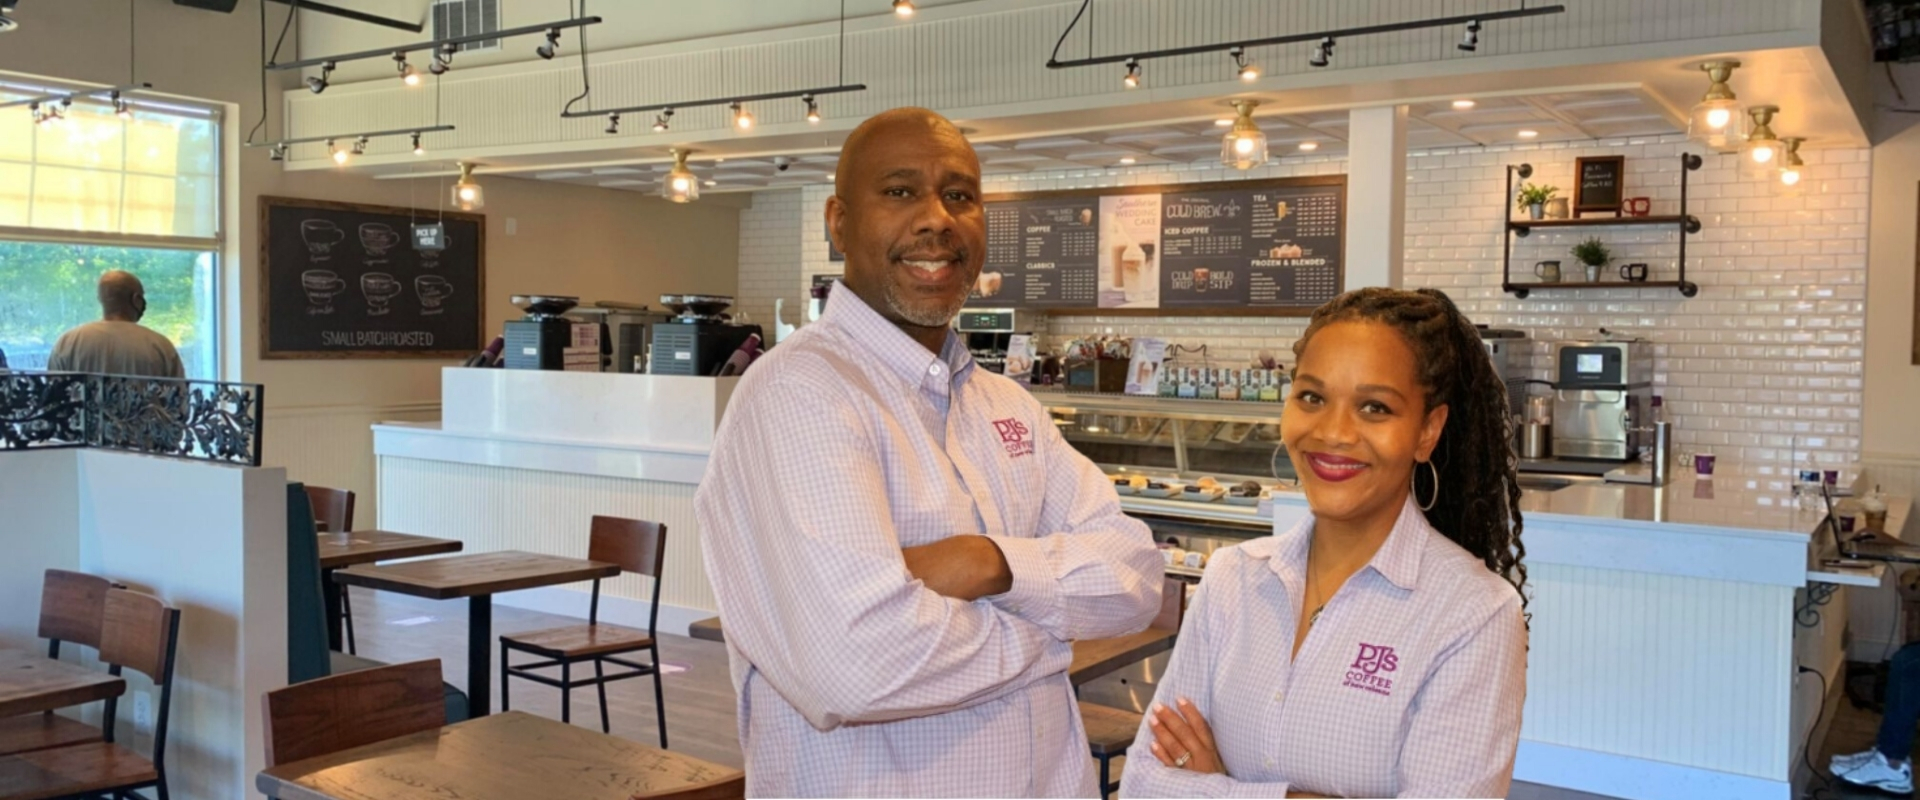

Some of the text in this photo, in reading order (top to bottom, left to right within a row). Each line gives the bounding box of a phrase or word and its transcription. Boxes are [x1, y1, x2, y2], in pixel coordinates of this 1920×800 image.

[1253, 194, 1267, 202] TEA
[1115, 208, 1157, 218] WEDDING
[1166, 204, 1192, 219] COLD
[1134, 218, 1157, 227] CAKE
[1026, 225, 1051, 233] COFFEE
[1164, 226, 1209, 235] ICED COFFEE
[1026, 262, 1056, 270] CLASSICS
[1291, 258, 1326, 267] BLENDED
[1171, 270, 1194, 281] COLD
[1210, 280, 1233, 290] SIP
[321, 330, 434, 347] SMALL BATCH ROASTED
[1345, 671, 1393, 689] COFFEE
